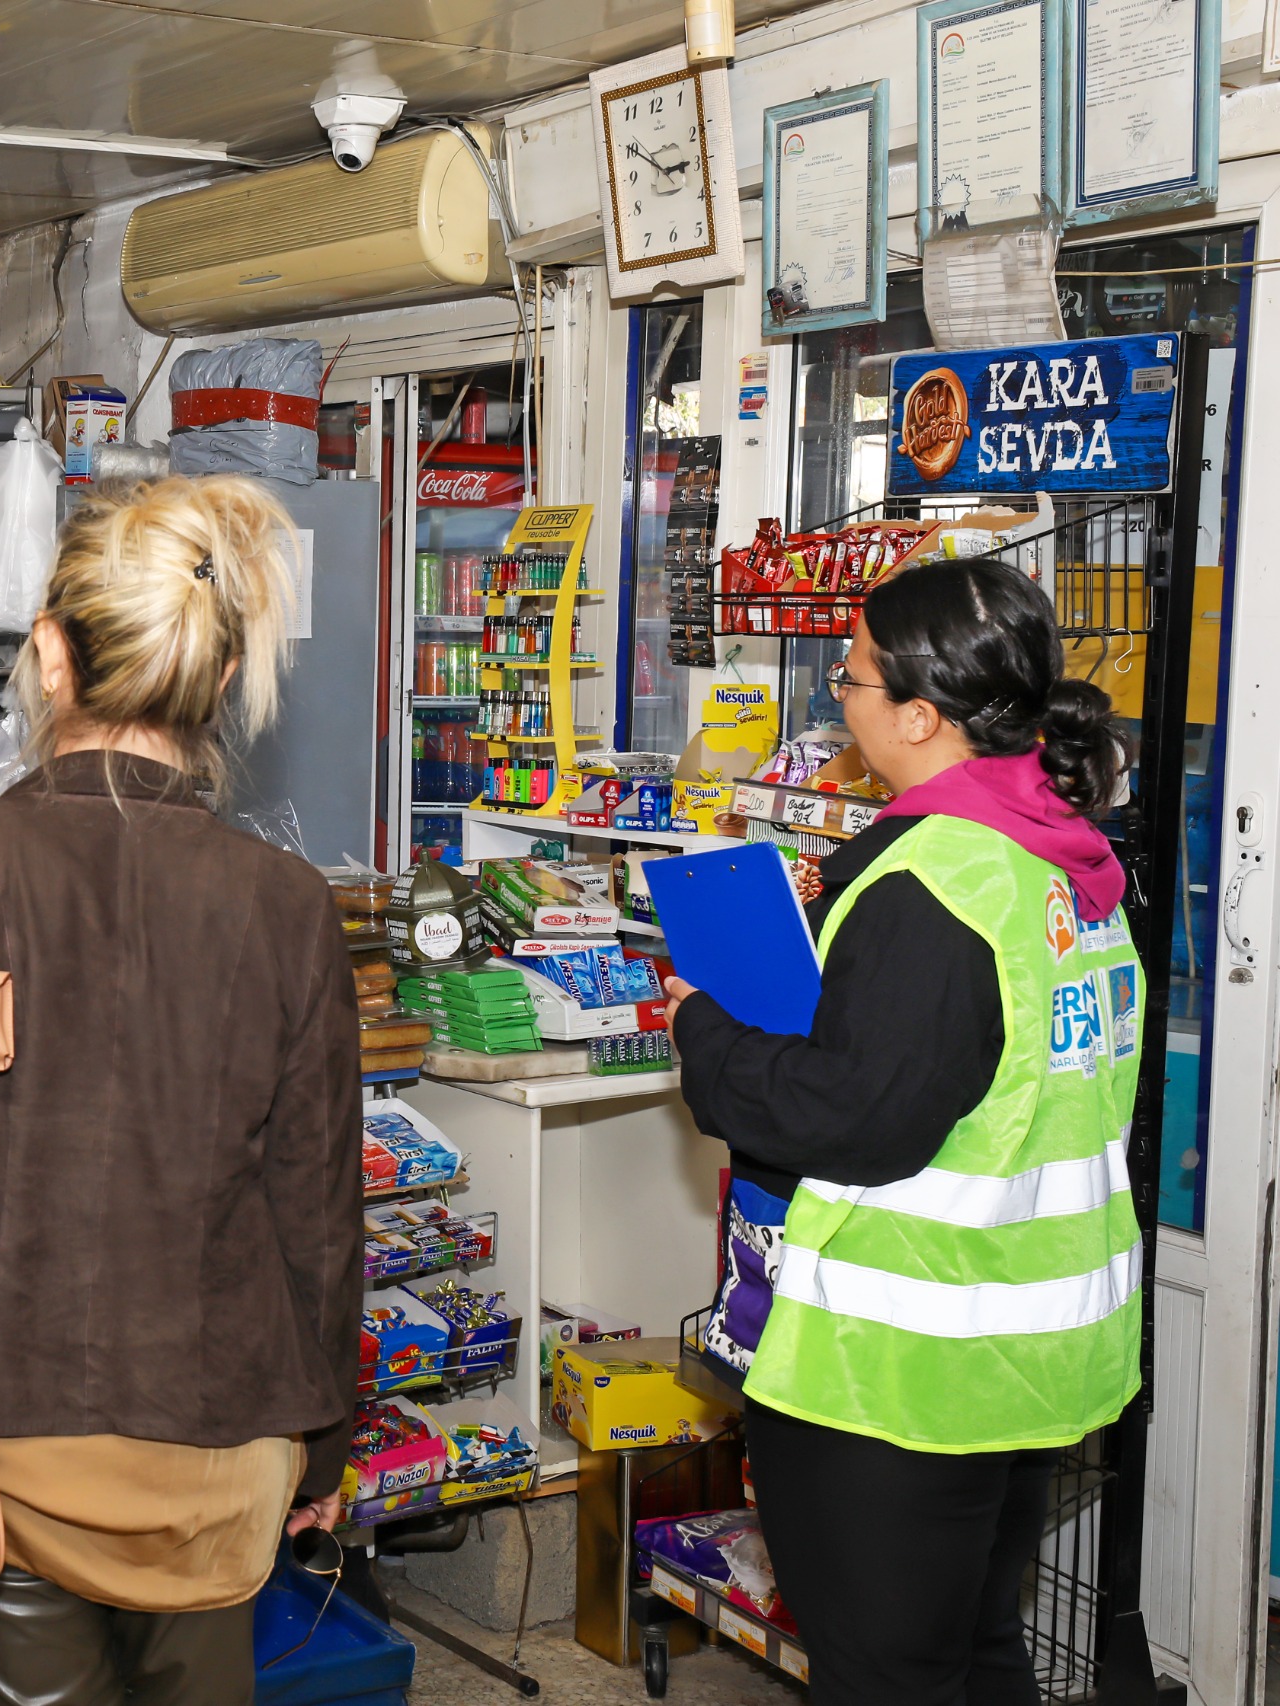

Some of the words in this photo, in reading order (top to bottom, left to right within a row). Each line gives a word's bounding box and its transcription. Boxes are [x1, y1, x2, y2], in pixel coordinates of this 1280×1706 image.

[649, 96, 663, 115] 12
[677, 90, 683, 108] 1
[623, 104, 638, 122] 11
[689, 126, 697, 142] 2
[693, 155, 701, 172] 3
[629, 170, 638, 187] 9
[632, 200, 642, 216] 8
[669, 225, 678, 243] 6
[693, 221, 703, 238] 5
[643, 232, 653, 248] 7
[984, 355, 1109, 412] KARA
[915, 382, 952, 426] Gold
[905, 412, 963, 452] Harvest
[977, 418, 1117, 474] SEVDA
[417, 472, 492, 501] Coca-Cola
[531, 511, 571, 526] CLIPPER
[527, 529, 561, 539] reusable
[716, 689, 765, 706] Nesquik
[735, 707, 752, 720] sütü
[739, 714, 768, 724] sevdirir!
[685, 785, 721, 798] Nesquik
[397, 1148, 424, 1161] First
[610, 1424, 656, 1441] Nesquik
[395, 1465, 429, 1486] Nazar
